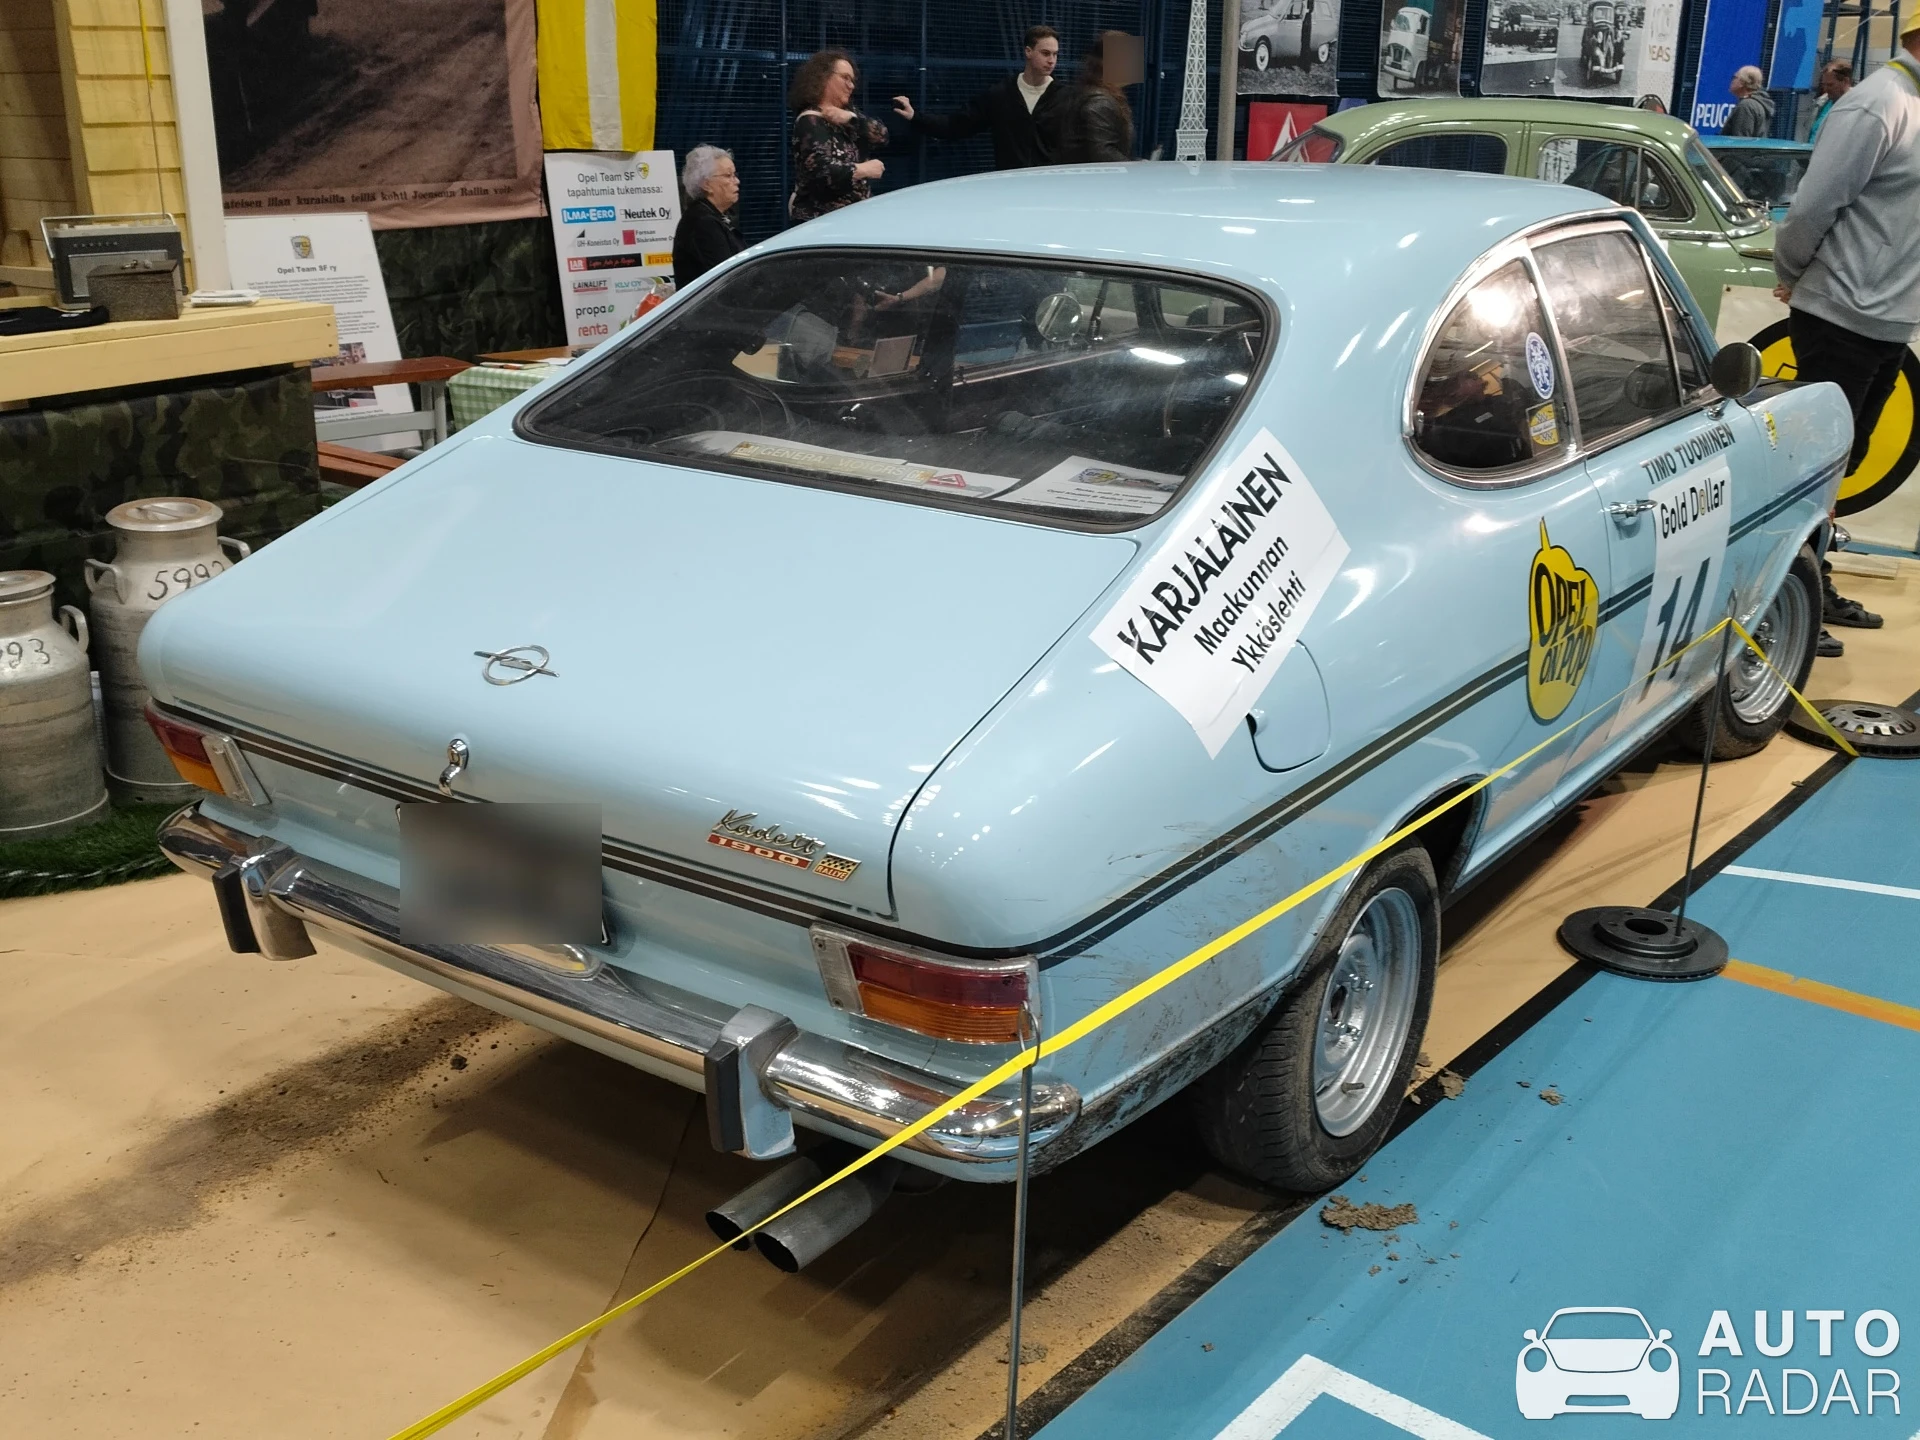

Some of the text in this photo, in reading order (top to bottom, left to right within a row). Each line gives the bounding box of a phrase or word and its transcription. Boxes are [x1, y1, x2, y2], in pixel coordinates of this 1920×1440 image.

[567, 185, 663, 198] tapahtumia tukemassa:
[577, 171, 635, 183] Opel Team SF
[624, 207, 671, 220] Neutek Oy
[277, 266, 294, 275] Opel
[297, 265, 317, 273] Team
[319, 264, 328, 272] SF
[572, 280, 607, 289] LAINALIFT
[575, 304, 607, 318] propa
[578, 323, 608, 337] renta
[760, 447, 829, 464] GENERAL
[1641, 422, 1737, 486] TIMO TUOMINEN
[1660, 478, 1726, 540] Gold Dollar
[1117, 452, 1293, 666] KARJALAINEN
[1193, 536, 1290, 656] Maakunnan
[1534, 562, 1589, 648] OPEL
[1231, 570, 1308, 674] Ykköslehti
[1638, 556, 1711, 704] 14
[1539, 624, 1594, 687] ON POP
[711, 808, 826, 856] Kadett
[716, 836, 801, 866] 1900
[815, 864, 848, 880] RALLYE
